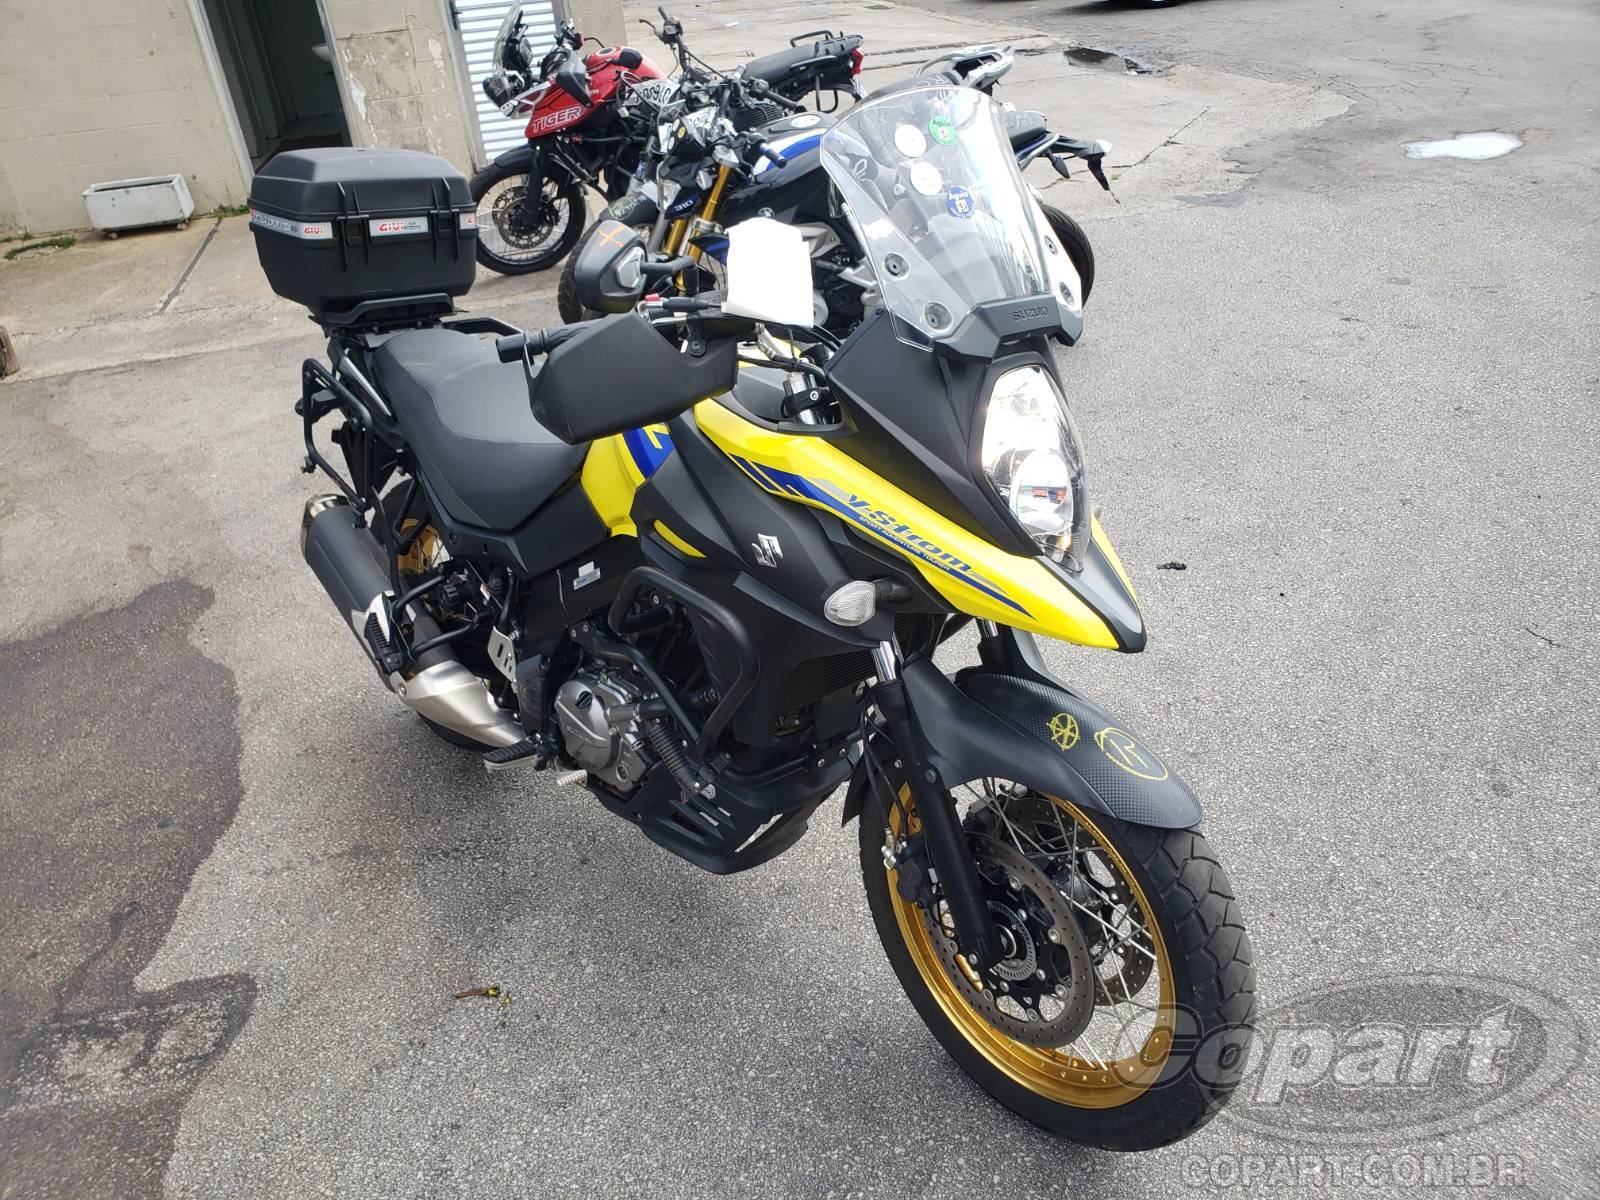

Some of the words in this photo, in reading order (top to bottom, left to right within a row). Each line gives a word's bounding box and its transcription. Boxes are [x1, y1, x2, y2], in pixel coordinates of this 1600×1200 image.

[529, 106, 582, 133] TIGER
[674, 199, 694, 212] 310
[303, 226, 324, 235] GIVI
[379, 221, 405, 232] GIVI
[1011, 304, 1049, 321] SUZUKI
[847, 494, 973, 572] V-Strom
[858, 515, 882, 532] SPORT
[881, 528, 922, 556] ADVENTURE
[922, 552, 950, 571] TOURER
